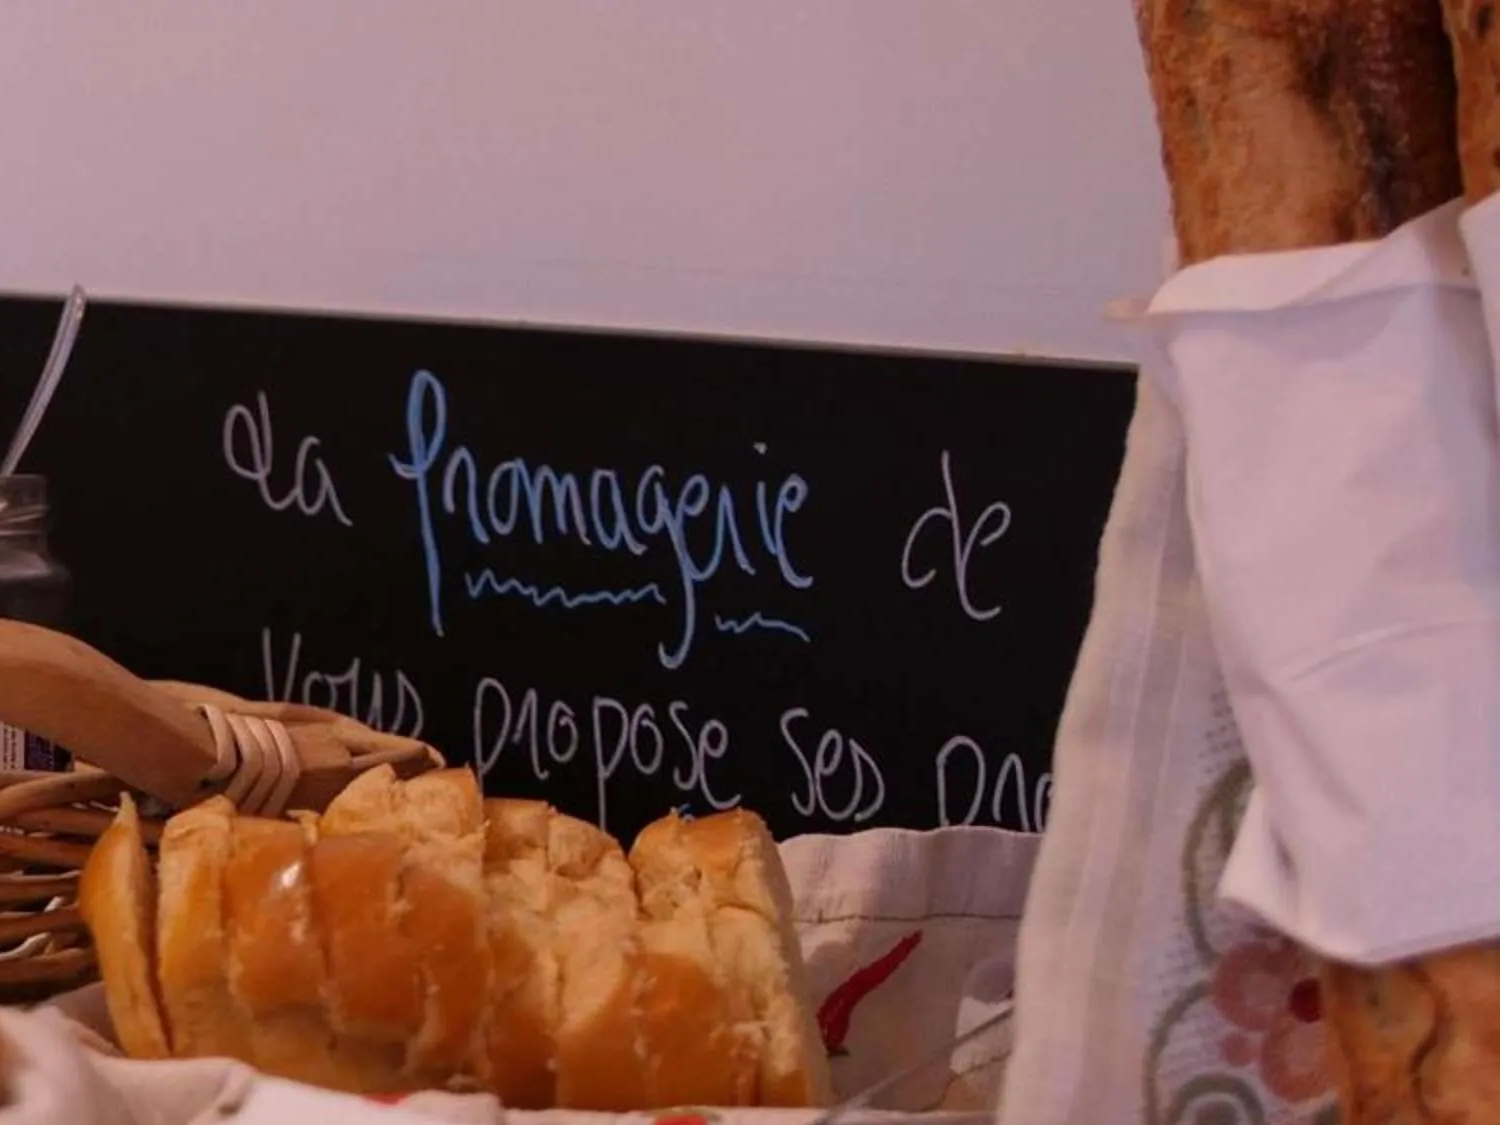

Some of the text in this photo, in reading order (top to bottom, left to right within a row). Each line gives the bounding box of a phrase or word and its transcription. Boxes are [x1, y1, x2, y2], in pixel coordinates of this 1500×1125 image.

[389, 369, 814, 669] fromagerie
[901, 451, 1012, 620] de
[474, 677, 741, 826] propose
